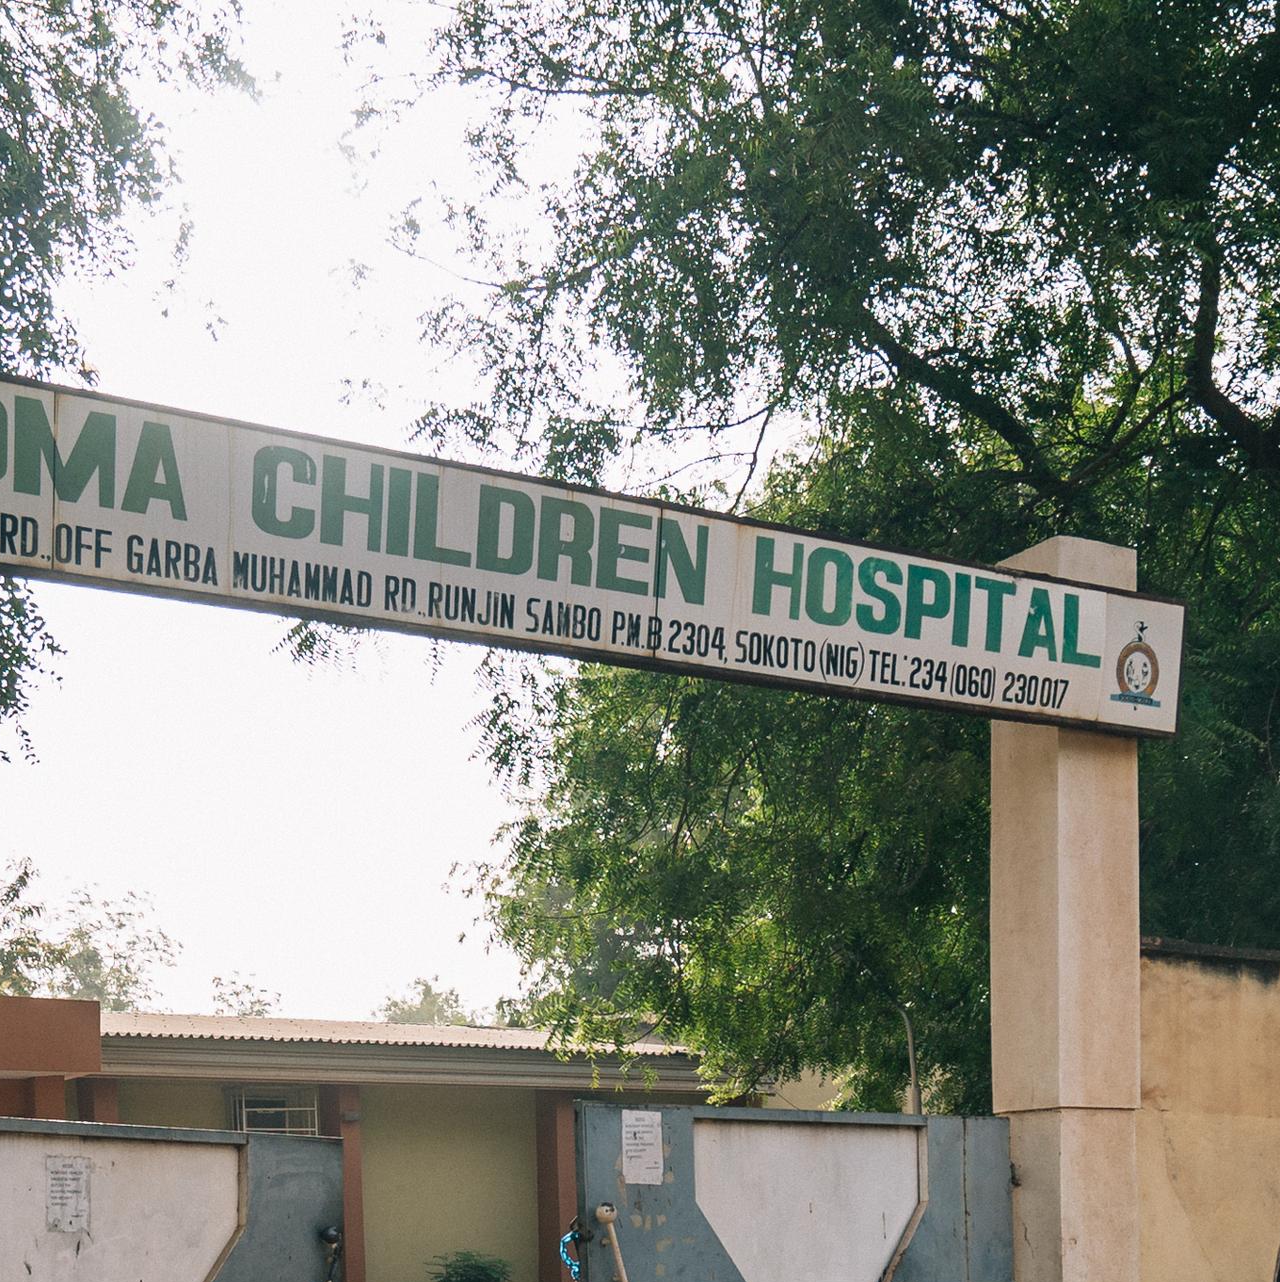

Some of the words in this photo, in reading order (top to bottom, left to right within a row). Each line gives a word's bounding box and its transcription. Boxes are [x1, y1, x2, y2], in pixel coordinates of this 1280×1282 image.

[55, 523, 113, 568] OFF
[126, 534, 219, 587] GARBA
[232, 551, 373, 608] MUHAMMAD
[428, 582, 516, 630] RUNJIN
[525, 597, 601, 642] SAMBO
[735, 630, 816, 673] SOKOTO
[1002, 671, 1069, 709] 230017
[251, 444, 708, 607] CHILDREN
[752, 536, 1102, 668] HOSPITAL
